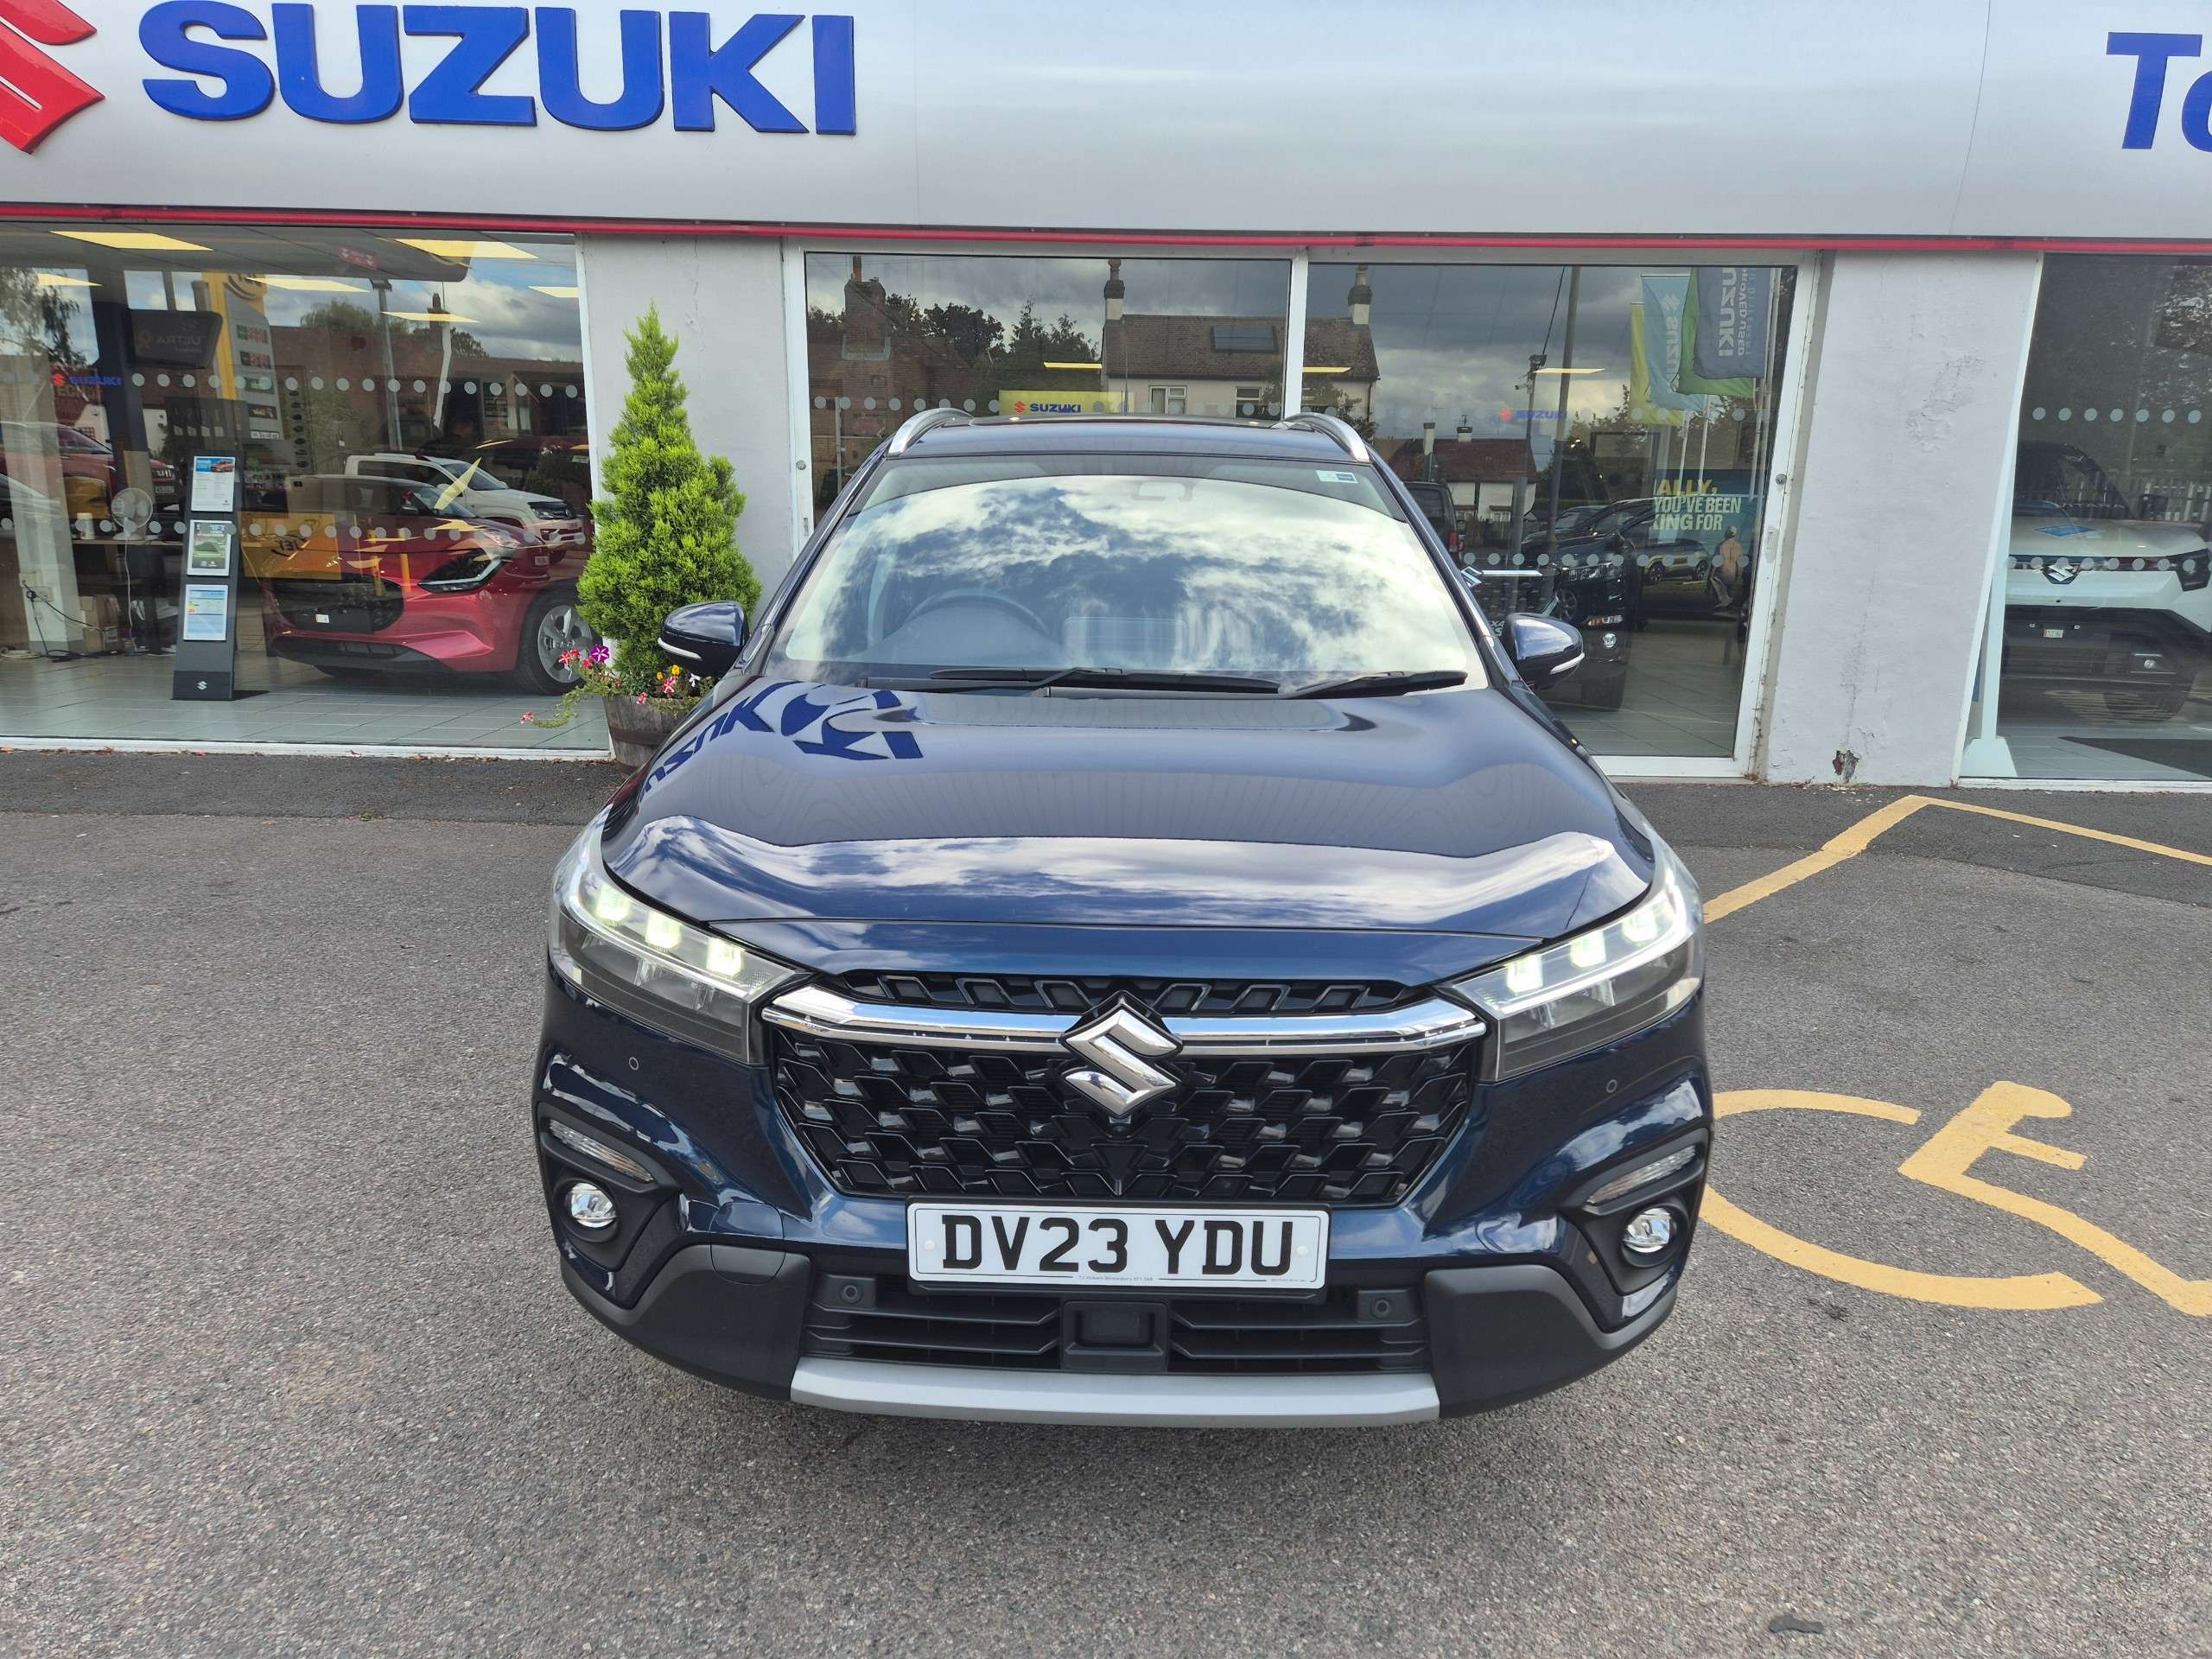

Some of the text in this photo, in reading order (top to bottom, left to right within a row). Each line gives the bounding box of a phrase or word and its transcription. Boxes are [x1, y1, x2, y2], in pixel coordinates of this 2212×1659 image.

[138, 0, 856, 136] SUZUKI
[1030, 403, 1082, 413] SUZUKI
[1653, 496, 1742, 513] YOU'VE BEEN
[1695, 514, 1724, 531] FOR
[942, 1214, 1294, 1276] DV23 YDU
